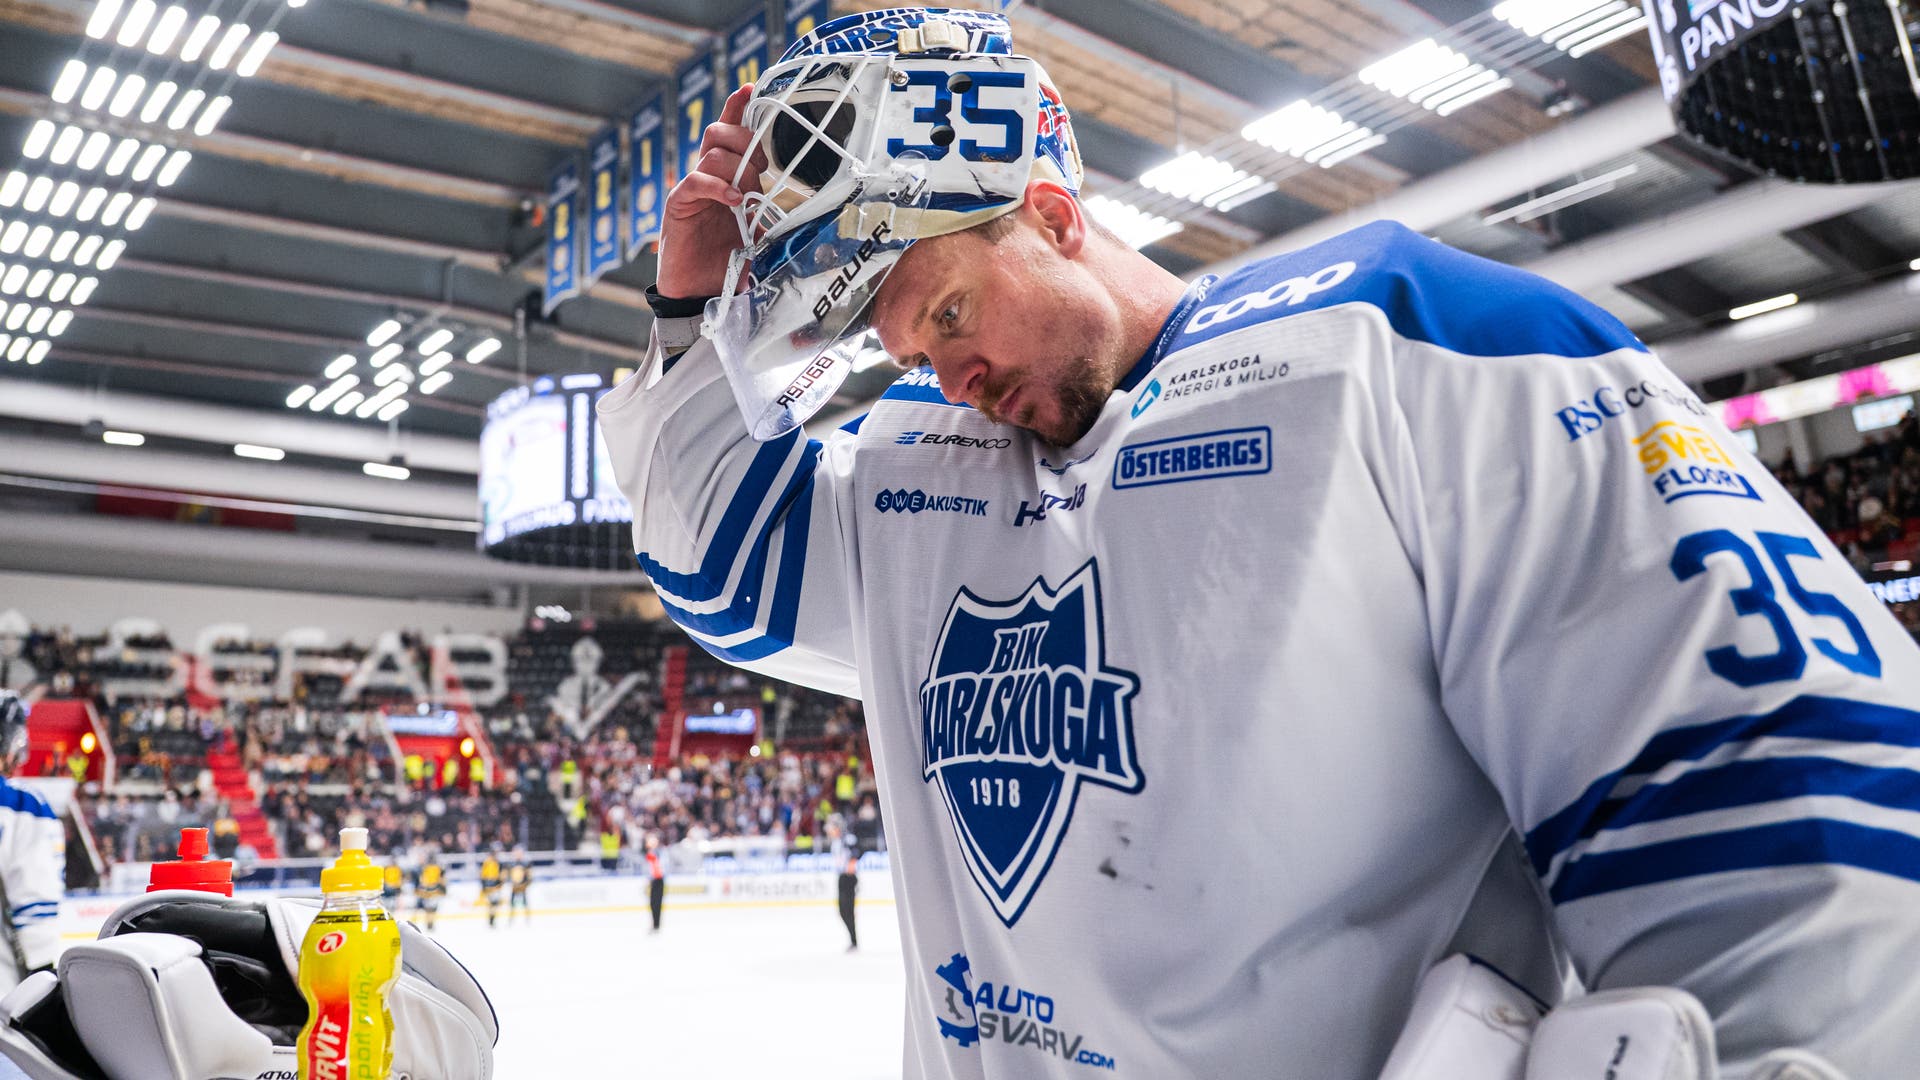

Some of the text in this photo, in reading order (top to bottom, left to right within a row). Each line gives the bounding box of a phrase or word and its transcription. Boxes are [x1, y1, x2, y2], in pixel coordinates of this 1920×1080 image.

[886, 70, 1026, 164] 35
[812, 220, 891, 322] BAUER
[1184, 261, 1356, 334] coop
[1163, 362, 1289, 402] ENERGI & MILJÖ
[1168, 354, 1261, 386] KARLSKOGA
[920, 433, 1011, 450] EURENCO
[1120, 438, 1262, 480] ÖSTERBERGS
[1654, 465, 1738, 496] FLOOR
[1669, 528, 1882, 688] 35
[991, 621, 1049, 674] BIK
[921, 670, 1131, 777] KARLSKOGA
[969, 777, 1021, 808] 1978
[975, 981, 1055, 1024] AUTO
[314, 1014, 341, 1080] RVIT
